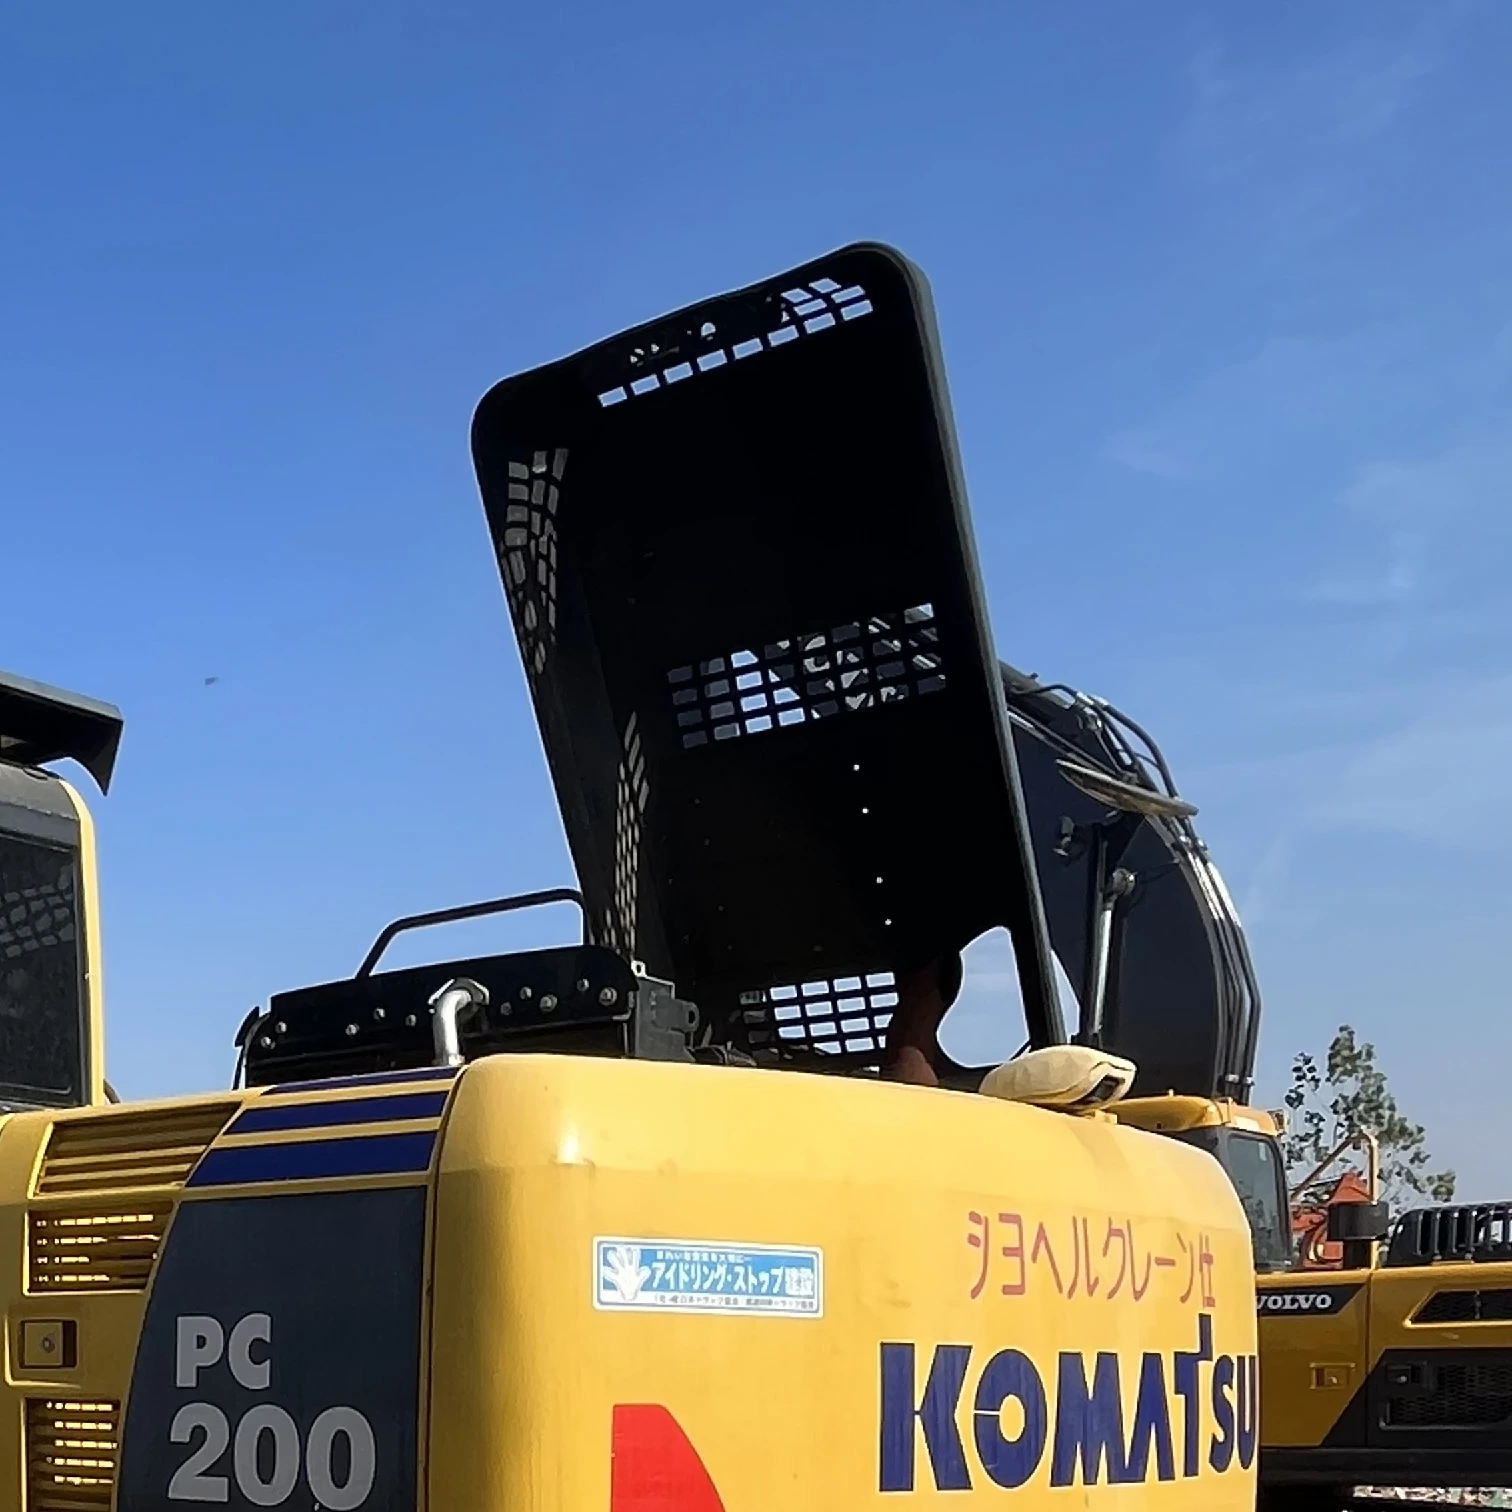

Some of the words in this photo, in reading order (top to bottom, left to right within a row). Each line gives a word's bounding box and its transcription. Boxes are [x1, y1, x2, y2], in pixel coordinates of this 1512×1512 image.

[1256, 1294, 1332, 1310] VOLVO
[176, 1312, 272, 1390] PC
[879, 1313, 1258, 1491] KOMATSU
[167, 1402, 377, 1512] 200
